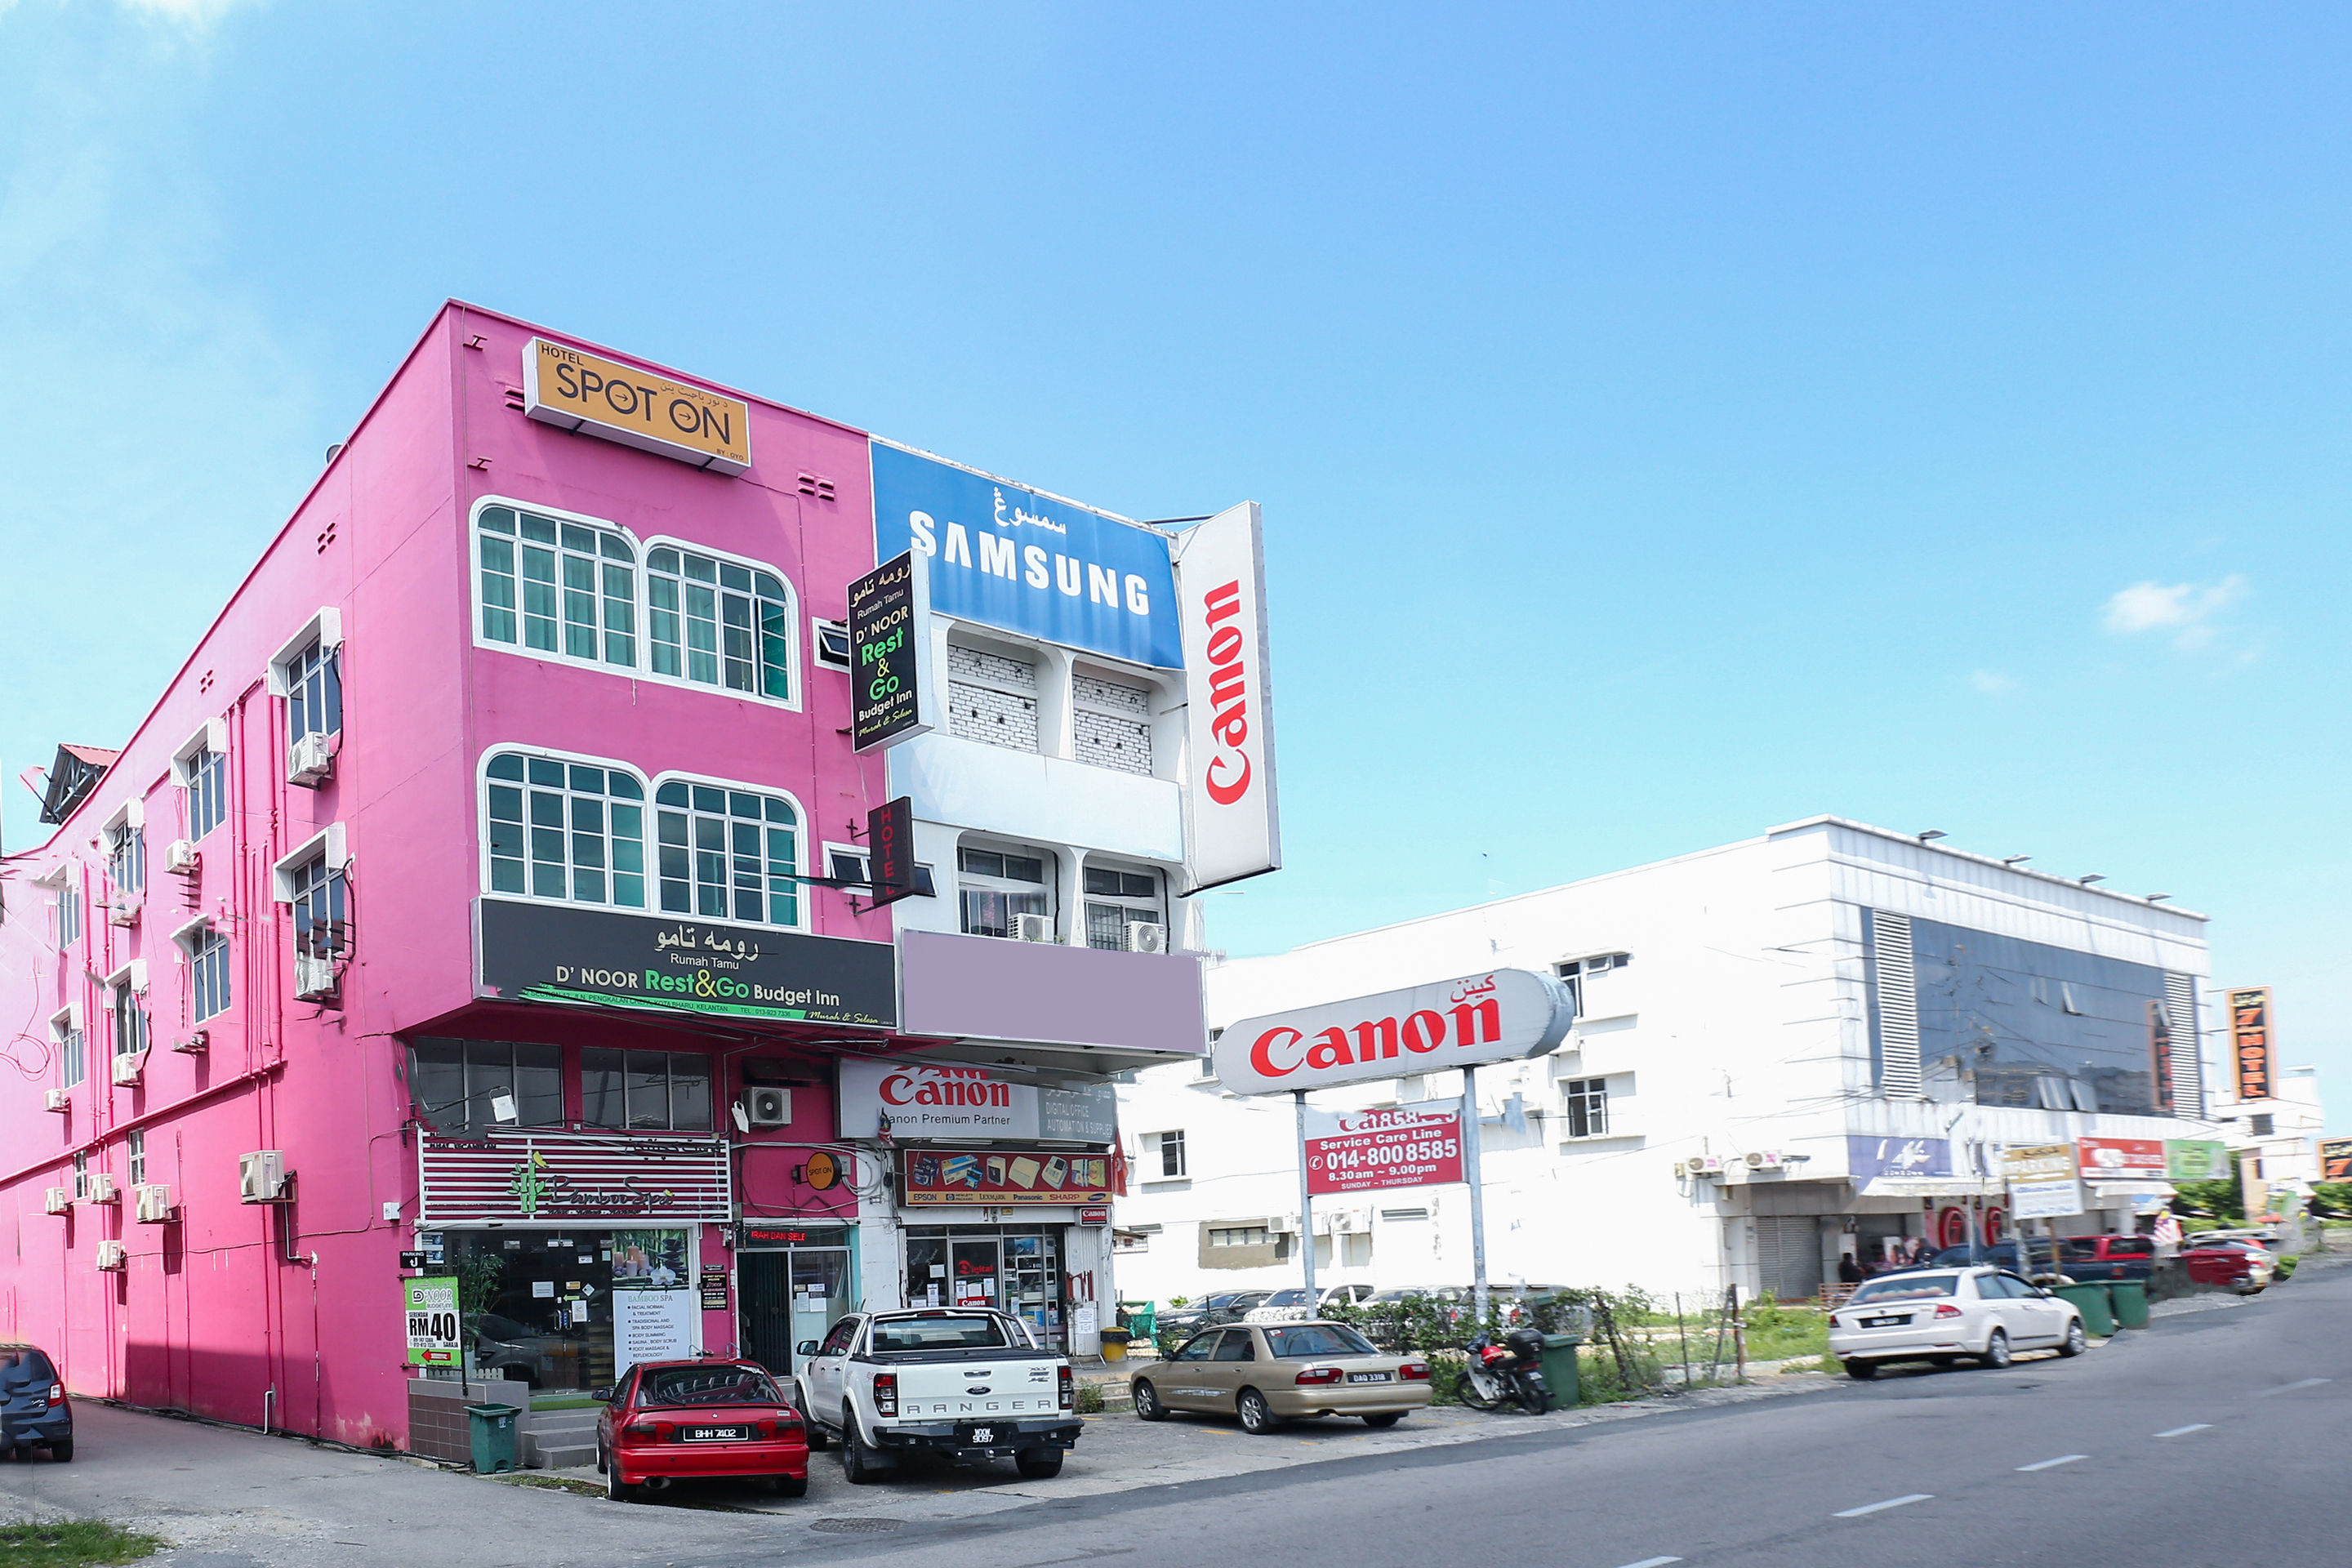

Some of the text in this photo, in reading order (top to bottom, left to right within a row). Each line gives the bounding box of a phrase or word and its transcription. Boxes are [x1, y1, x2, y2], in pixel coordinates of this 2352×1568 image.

[541, 344, 584, 367] HOTEL
[556, 363, 730, 445] SPOT ON
[730, 452, 744, 461] OYO
[909, 510, 1150, 616] SAMSUNG
[858, 589, 904, 620] Rumah Tamu
[871, 605, 909, 637] NOOR
[861, 626, 904, 666] Rest
[877, 657, 890, 677] &
[869, 675, 900, 701] Go
[1204, 579, 1251, 805] Canon
[858, 689, 913, 722] Budget Inn
[858, 719, 882, 737] Murah
[881, 807, 895, 896] HOTEL
[670, 953, 739, 970] Rumah Tamu
[581, 968, 638, 989] NOOR
[754, 984, 812, 1006] Budget
[816, 990, 840, 1006] Inn
[808, 1011, 840, 1021] Murah
[1250, 998, 1501, 1077] Canon
[880, 1074, 1009, 1107] Canon
[889, 1114, 1010, 1125] anon Premium Partner
[1046, 1102, 1089, 1118] DIGITAL OFFICE
[1047, 1119, 1085, 1133] AUTOMATION
[1320, 1129, 1442, 1151] Service Care Line
[808, 1168, 822, 1176] SPOT
[1328, 1168, 1374, 1182] 8.30am
[1389, 1164, 1437, 1177] 9.00pm
[1341, 1181, 1371, 1190] SUNDAY
[1381, 1176, 1423, 1186] THURSDAY
[546, 1175, 673, 1214] Bamboo Spa
[751, 1230, 769, 1239] RAH
[957, 1259, 994, 1275] Digital
[1270, 1329, 1282, 1337] P
[906, 1400, 1052, 1414] RANGER
[695, 1428, 737, 1437] BHH 7402
[973, 1435, 994, 1443] 9097
